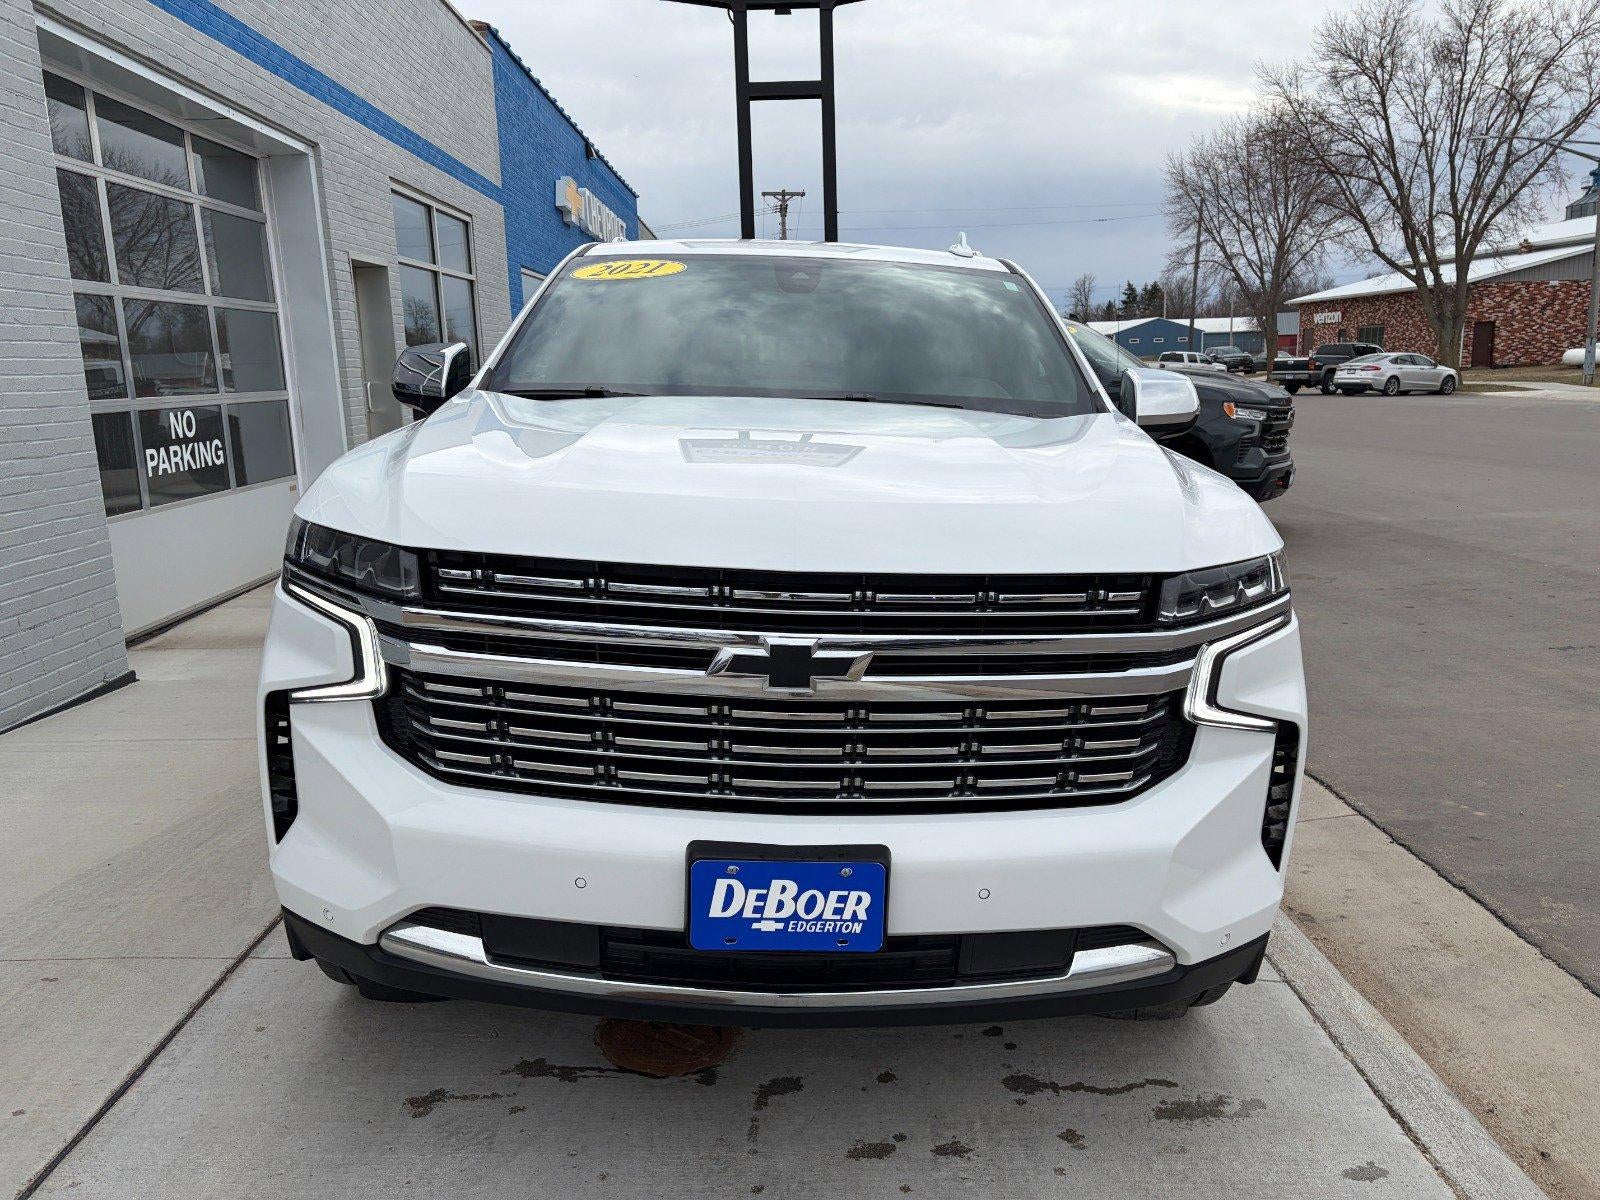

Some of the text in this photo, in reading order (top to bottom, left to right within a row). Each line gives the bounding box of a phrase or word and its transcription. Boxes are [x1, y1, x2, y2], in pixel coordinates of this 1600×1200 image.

[587, 261, 667, 277] 2021
[1313, 309, 1342, 324] verizon
[169, 410, 196, 439] NO
[145, 438, 225, 477] PARKING
[787, 920, 863, 934] EDGERTON
